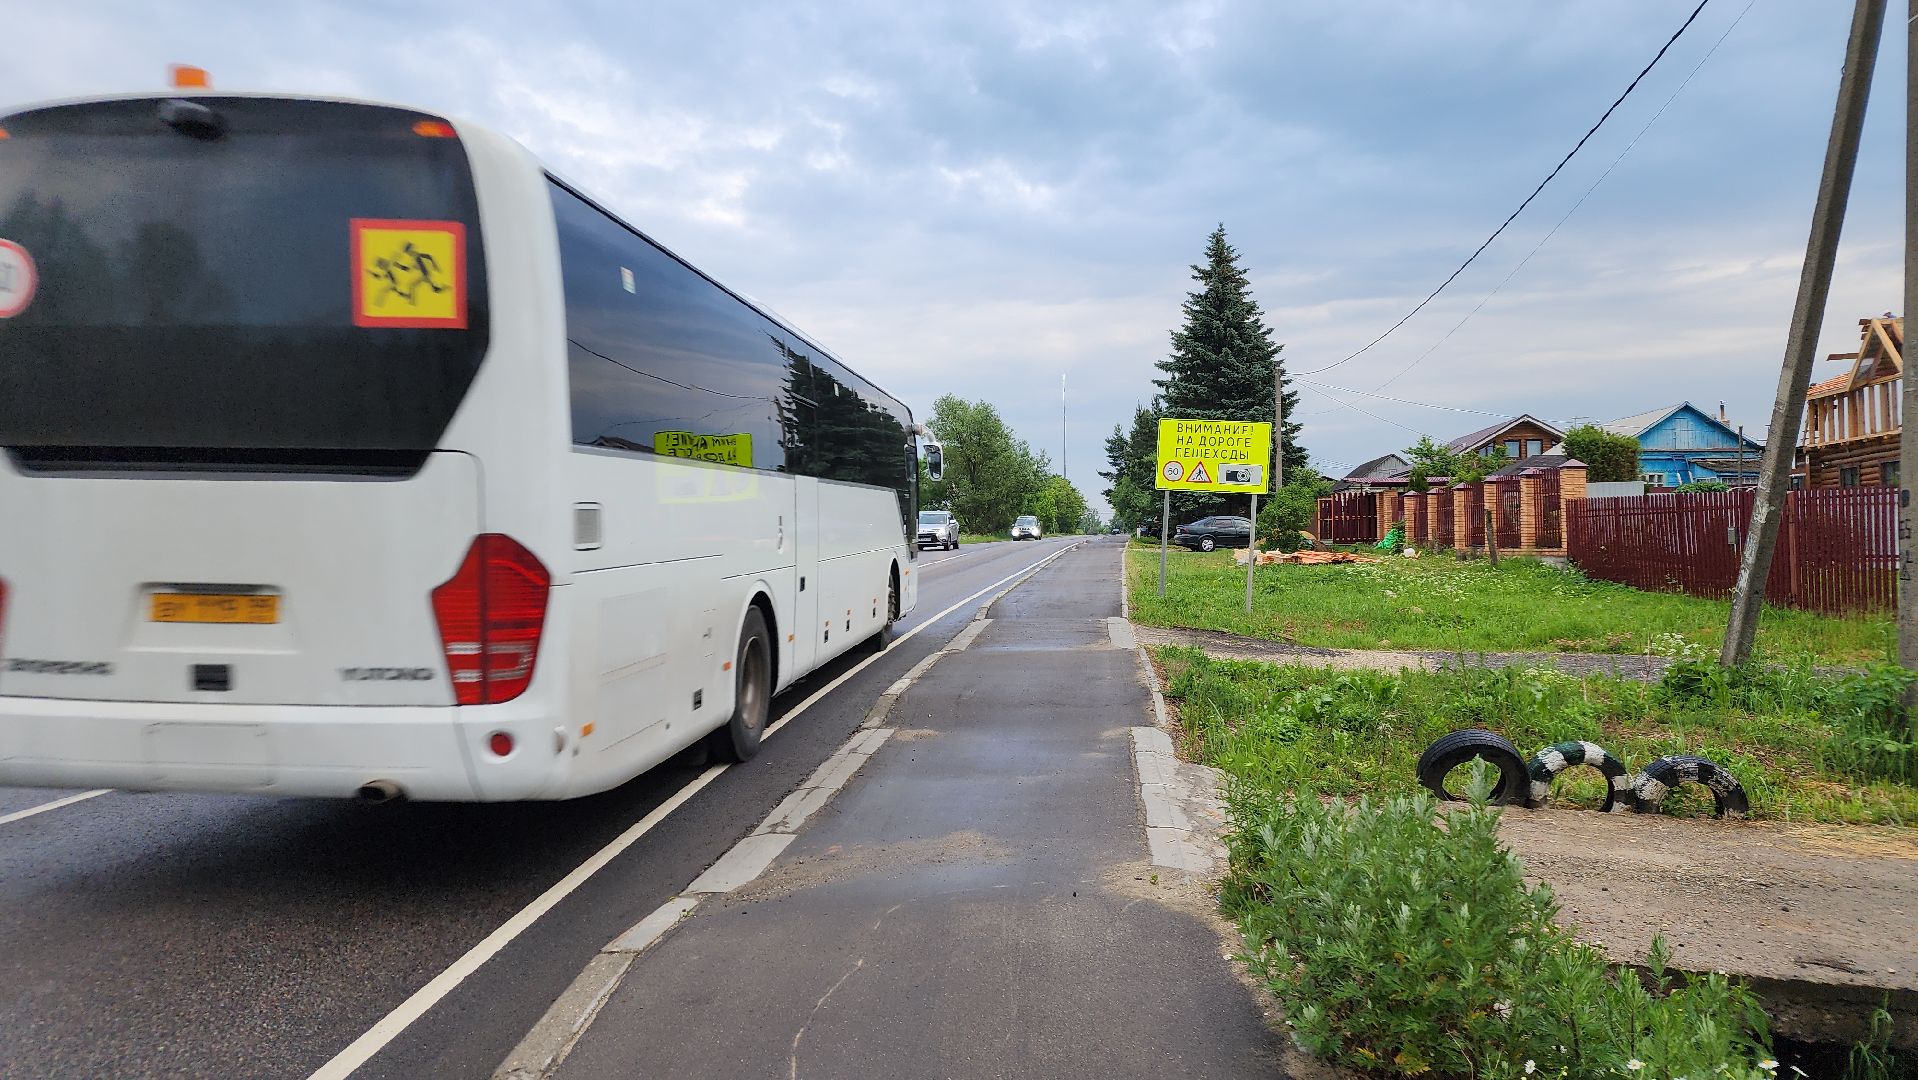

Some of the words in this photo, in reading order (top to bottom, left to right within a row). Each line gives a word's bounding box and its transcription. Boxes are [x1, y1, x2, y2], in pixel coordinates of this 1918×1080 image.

[1177, 423, 1254, 435] ВНИМАНИЕ!
[1177, 435, 1193, 446] НА
[1198, 436, 1252, 447] ДОРОГЕ
